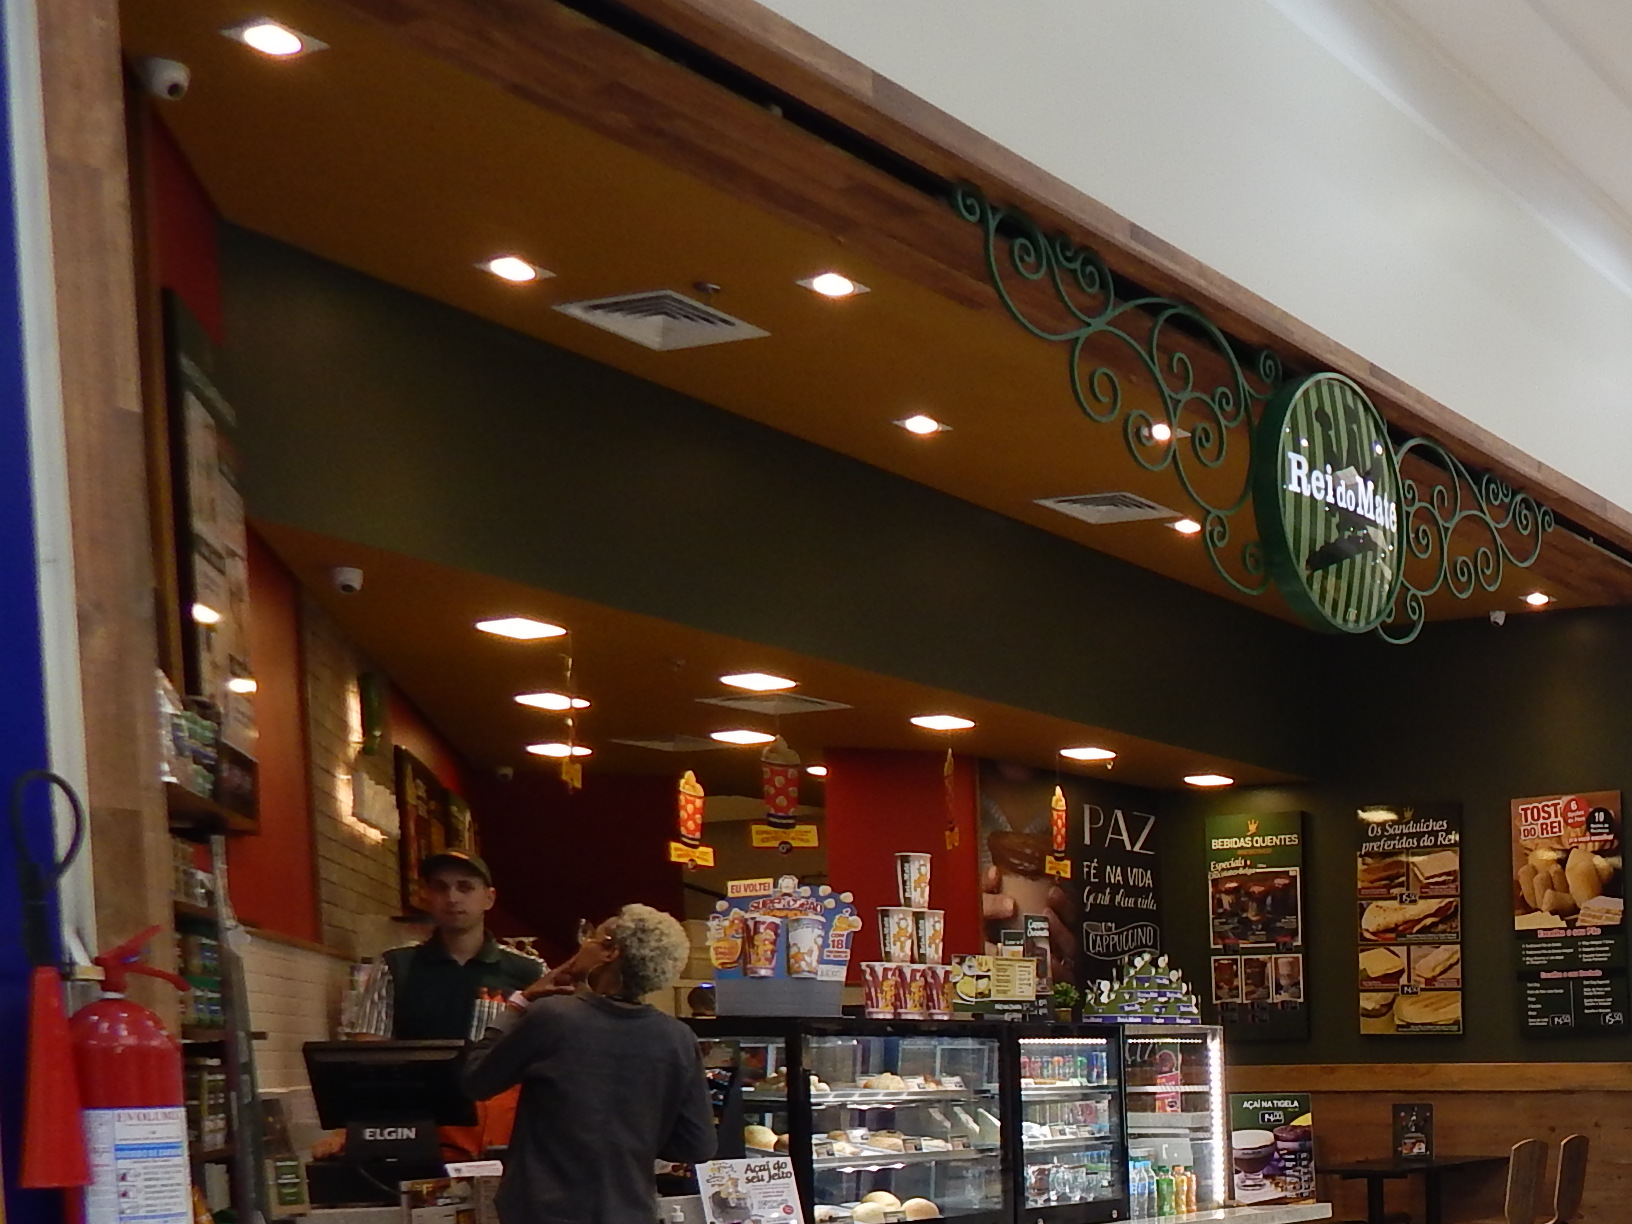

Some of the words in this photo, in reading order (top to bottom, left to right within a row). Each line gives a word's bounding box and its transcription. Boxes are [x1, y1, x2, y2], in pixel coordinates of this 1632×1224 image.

[1288, 451, 1335, 504] Rei
[1336, 480, 1355, 512] do
[1356, 475, 1397, 533] Mate
[1571, 801, 1578, 810] 6
[1521, 802, 1561, 824] TOST
[1594, 811, 1605, 822] 10
[1083, 804, 1156, 855] PAZ
[1368, 823, 1382, 837] Os
[1523, 827, 1537, 838] DO
[1540, 819, 1562, 836] REI
[1211, 837, 1252, 849] BEBIDAS
[1253, 834, 1299, 847] QUENTES
[1362, 835, 1418, 855] preferidos
[1420, 833, 1435, 847] do
[1437, 830, 1456, 845] Rei
[1083, 858, 1099, 882] FÉ
[1105, 865, 1123, 885] NA
[1127, 866, 1153, 888] VIDA
[731, 884, 742, 894] EU
[831, 939, 844, 949] 18
[1089, 926, 1154, 954] CAPPUCCINO
[1273, 1100, 1300, 1108] TIGELA
[365, 1127, 416, 1140] ELGIN
[773, 1159, 788, 1172] do
[744, 1174, 765, 1185] seu
